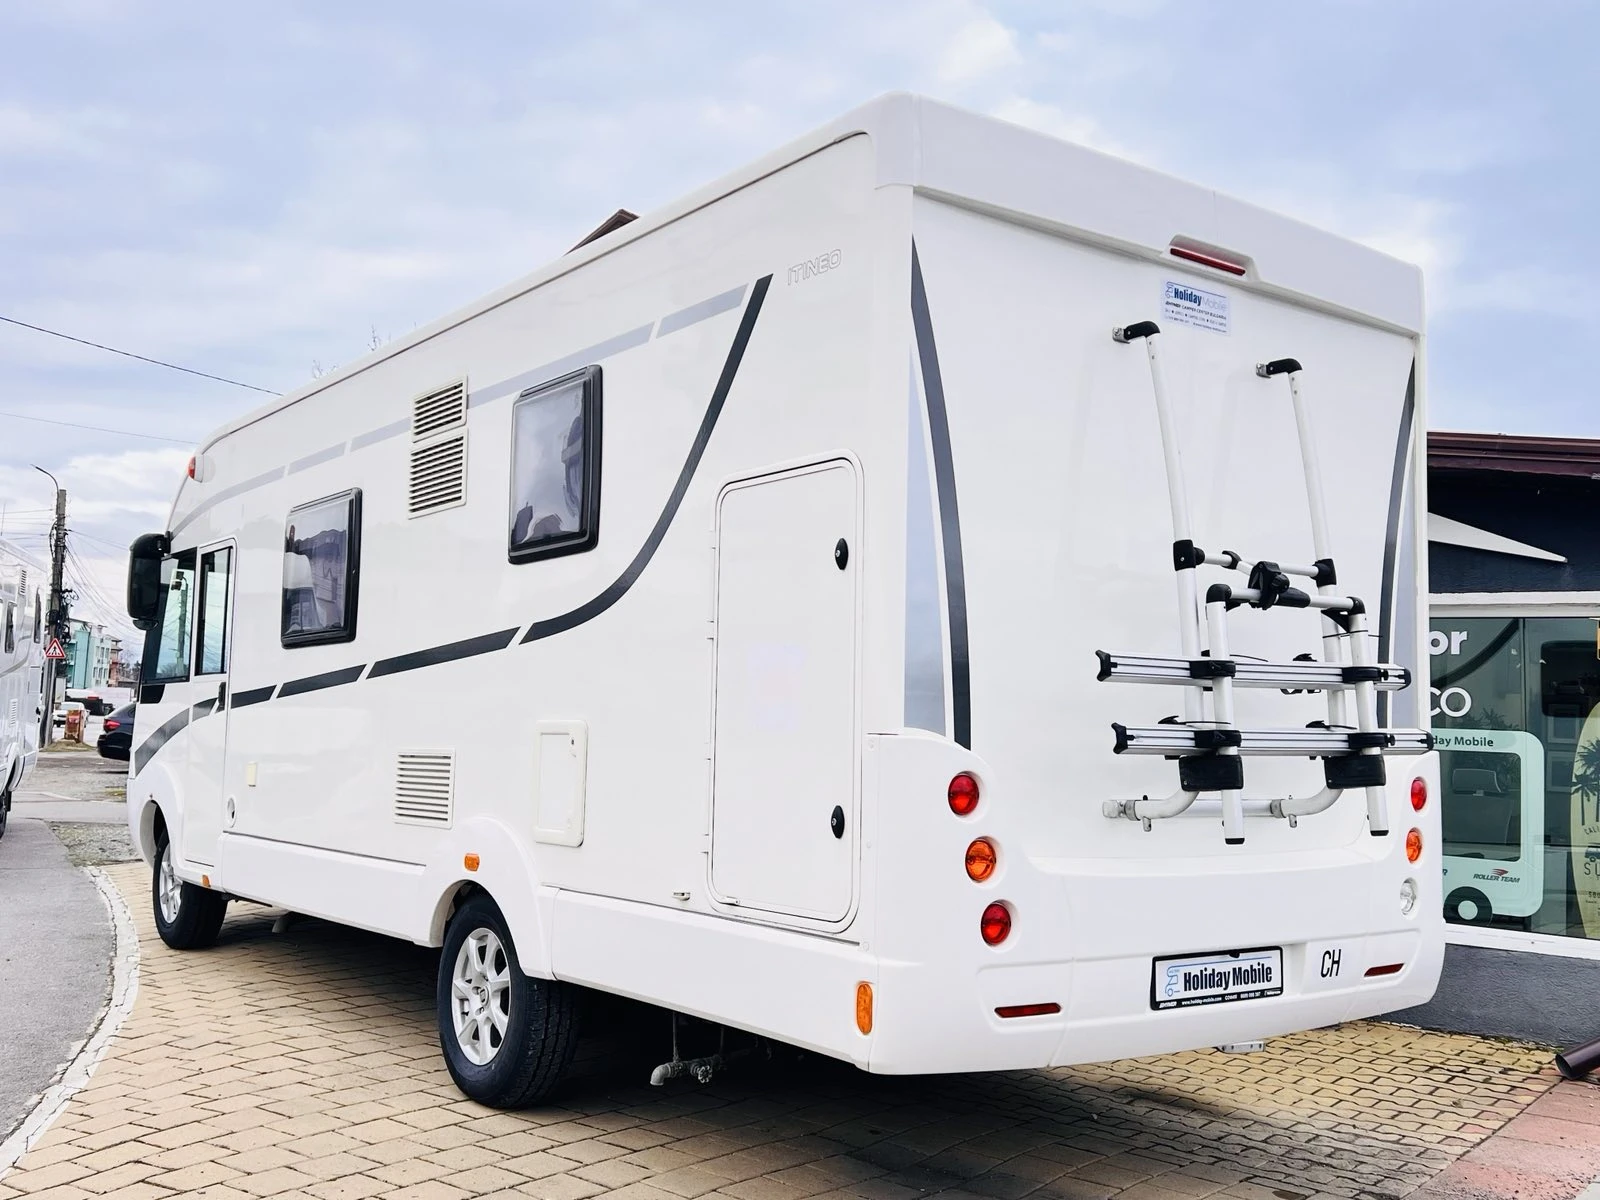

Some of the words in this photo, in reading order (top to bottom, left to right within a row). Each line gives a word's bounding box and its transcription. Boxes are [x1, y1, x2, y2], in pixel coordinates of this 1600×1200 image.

[788, 248, 841, 286] ITINEO
[1173, 287, 1202, 306] Holiday
[1454, 736, 1494, 747] Mobile
[1473, 873, 1500, 881] ROLLER
[1321, 949, 1341, 978] CH
[1183, 967, 1230, 991] Holiday
[1232, 962, 1273, 986] Mobile
